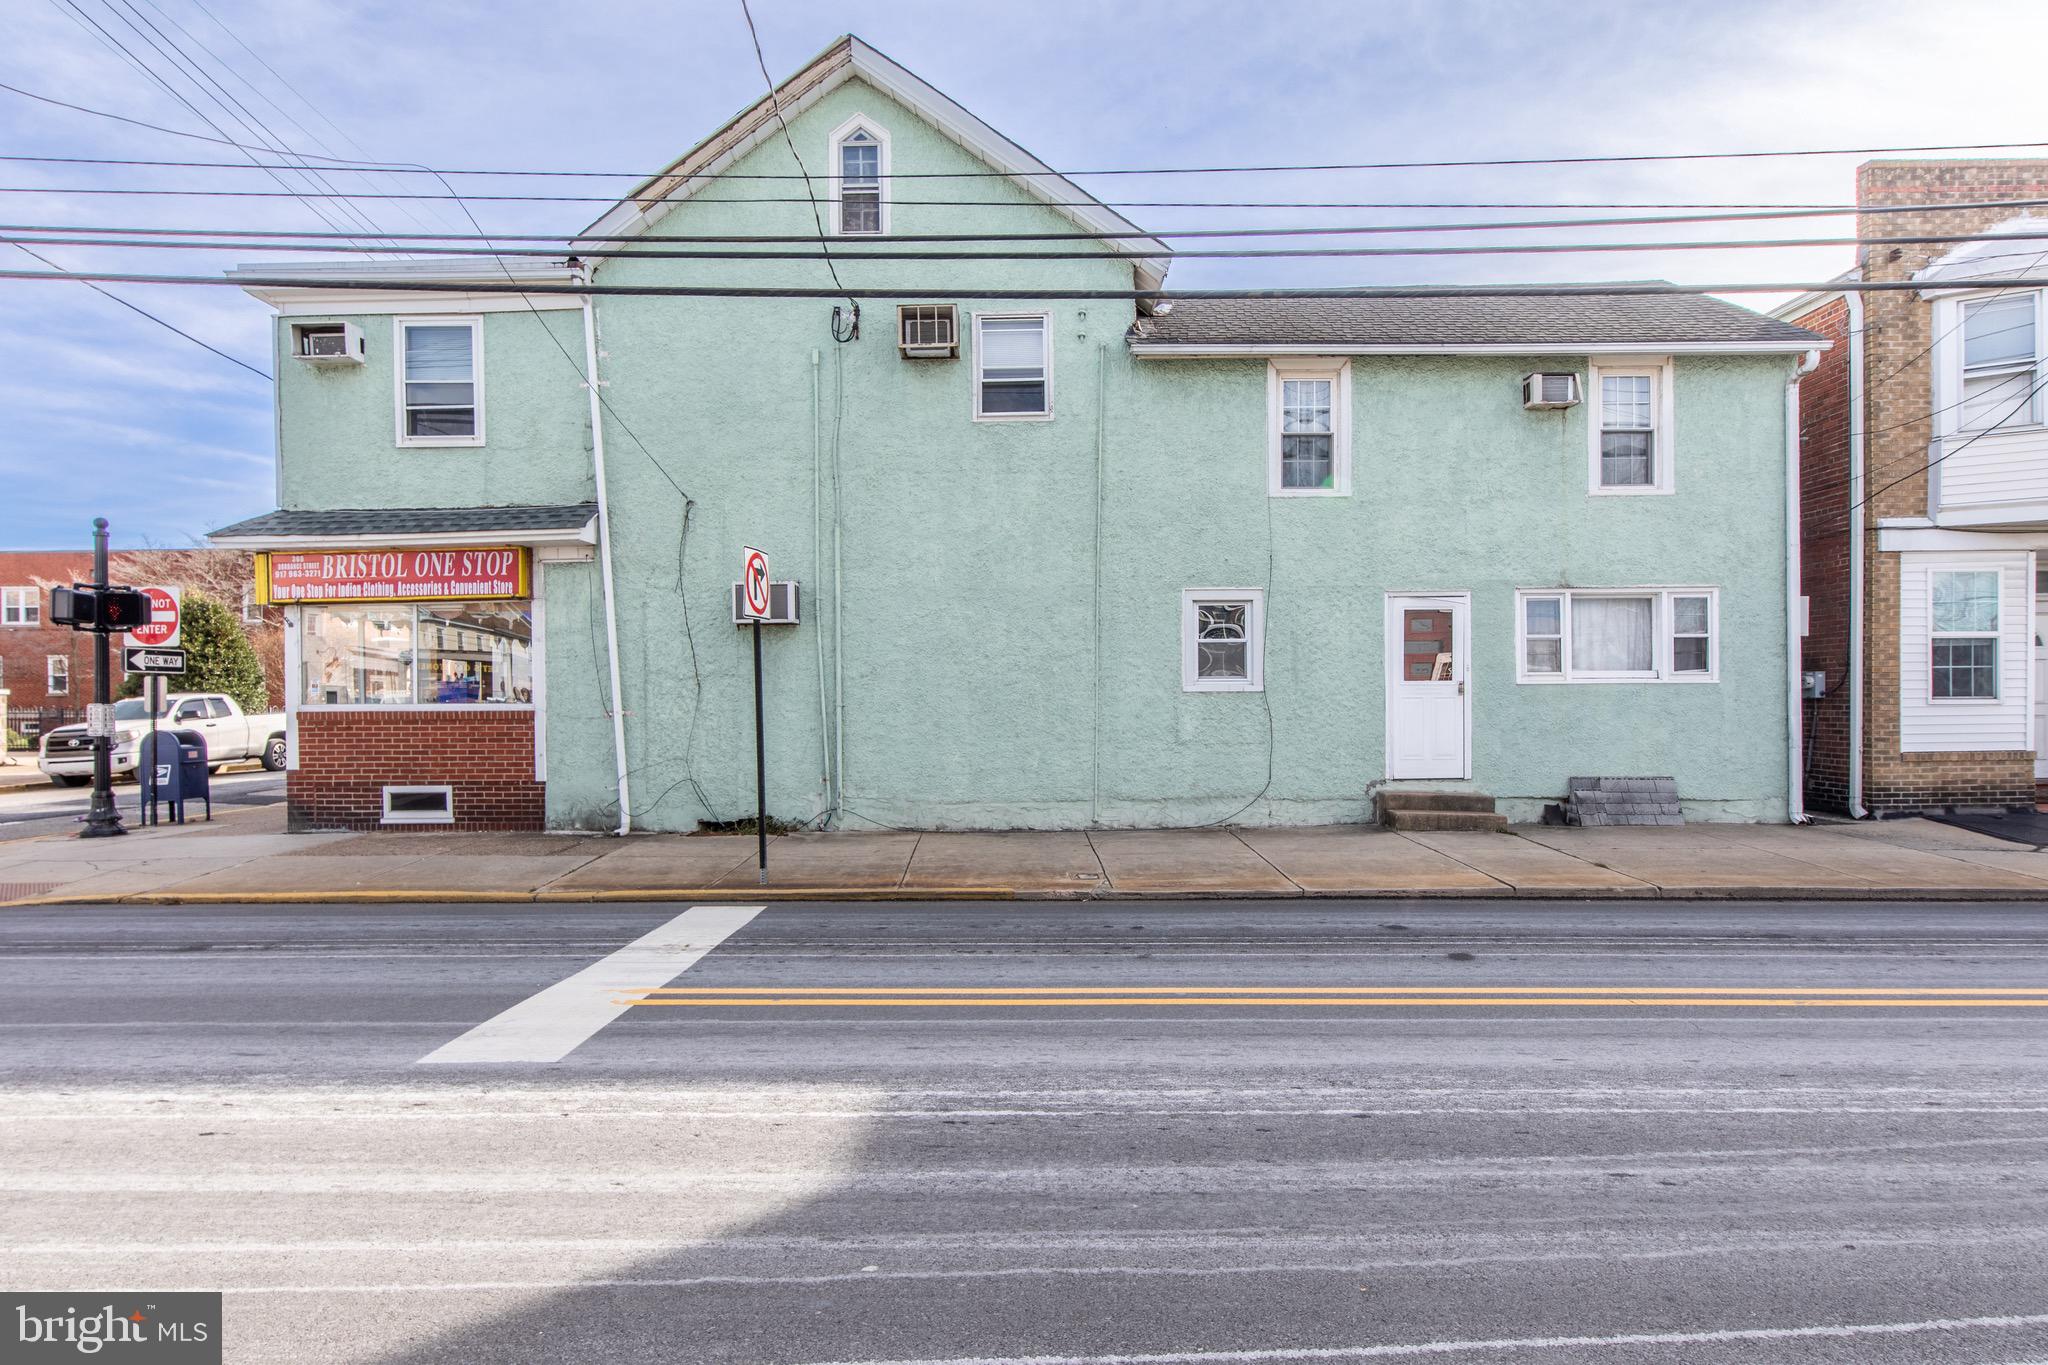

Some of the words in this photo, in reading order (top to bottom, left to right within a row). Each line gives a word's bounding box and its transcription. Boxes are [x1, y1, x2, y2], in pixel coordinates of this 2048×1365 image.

[303, 562, 320, 570] STREET
[322, 552, 408, 579] BRISTOL
[415, 552, 456, 577] ONE
[461, 551, 514, 576] STOP
[273, 584, 290, 599] Your
[291, 584, 305, 598] One
[307, 583, 323, 599] Stop
[325, 583, 337, 597] For
[338, 582, 362, 598] Indian
[363, 581, 396, 598] Clothing,
[397, 581, 442, 597] Accessories
[444, 582, 449, 595] &
[450, 580, 492, 595] Convenient
[493, 579, 513, 595] Store
[152, 599, 171, 609] NOT
[136, 624, 168, 635] ENTER
[144, 656, 160, 665] ONE
[163, 656, 179, 666] WAY
